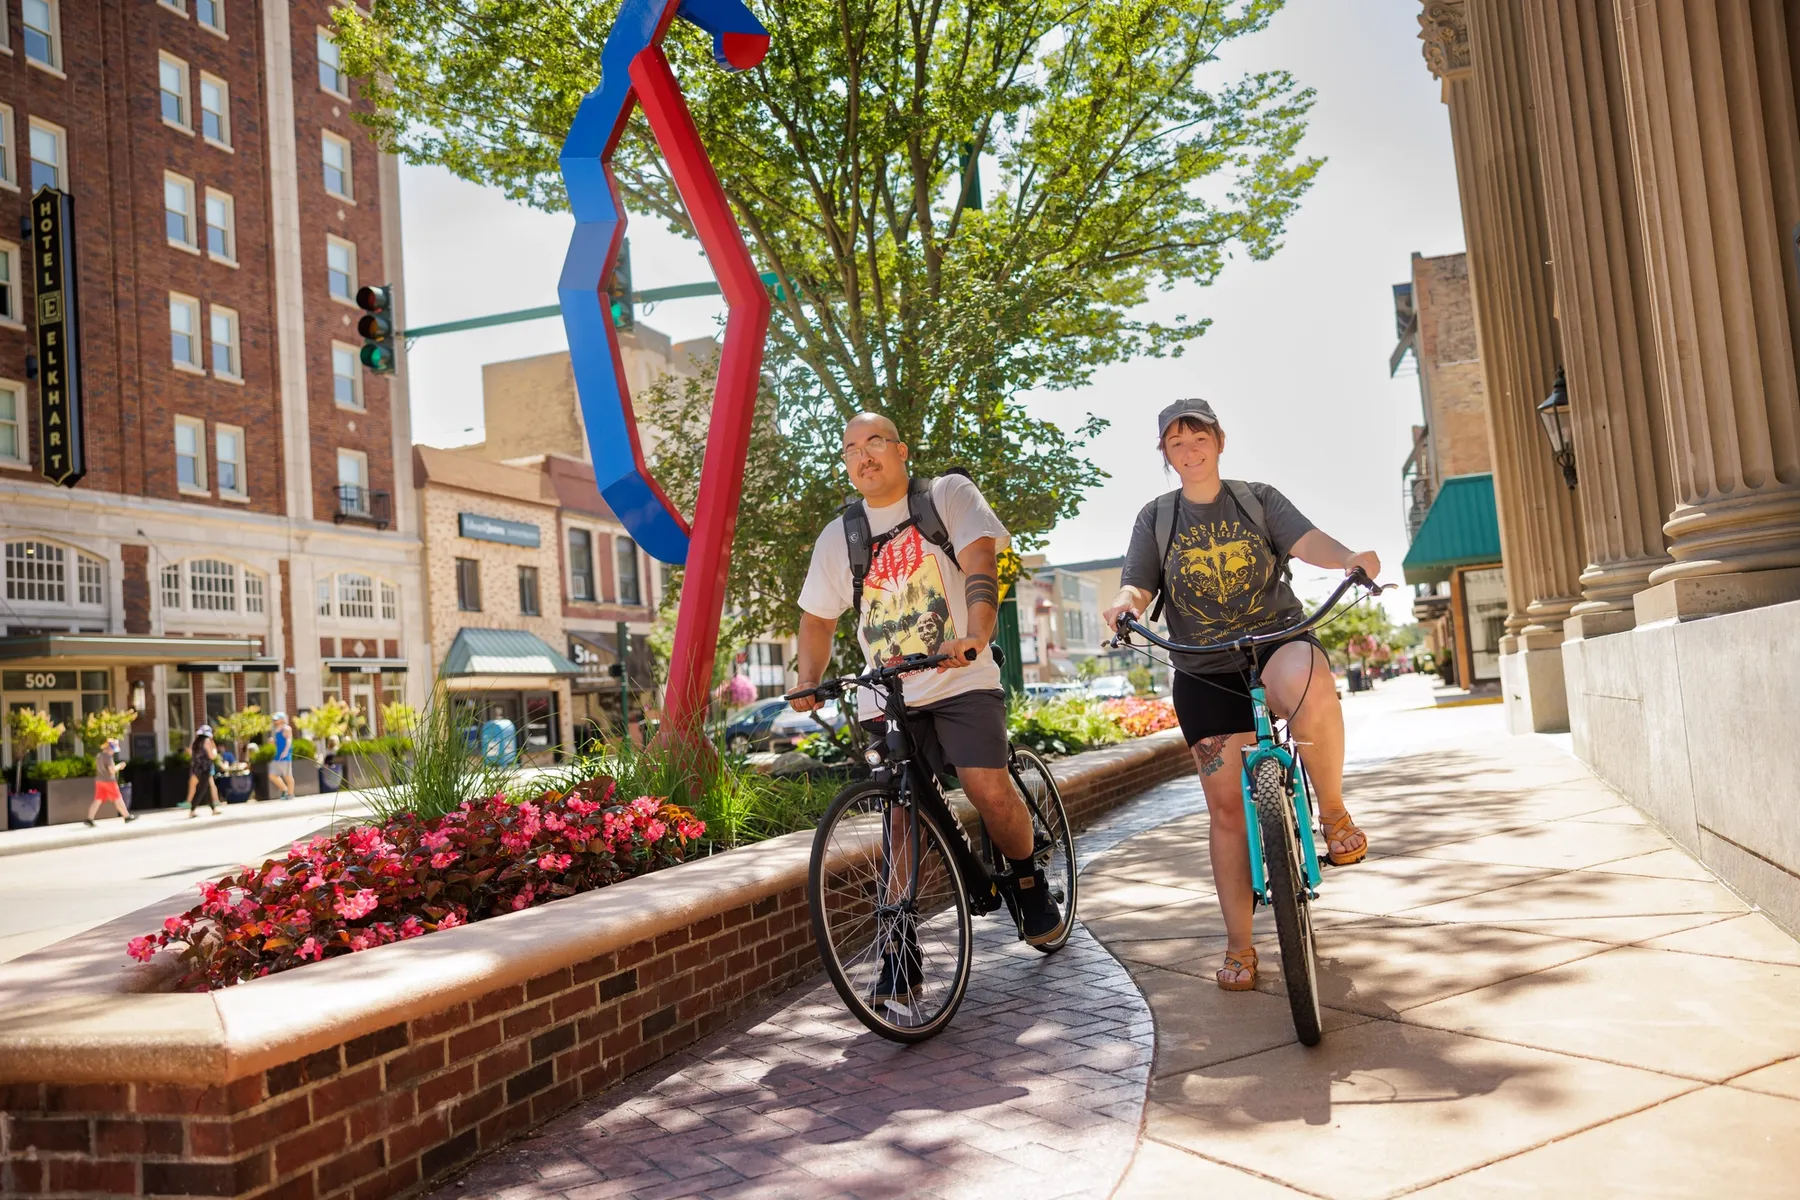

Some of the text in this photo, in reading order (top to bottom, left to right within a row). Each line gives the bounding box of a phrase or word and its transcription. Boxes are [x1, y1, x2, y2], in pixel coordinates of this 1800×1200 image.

[40, 201, 54, 287] HOTEL
[44, 298, 57, 319] E
[46, 331, 62, 469] ELKHART
[25, 672, 57, 689] 500
